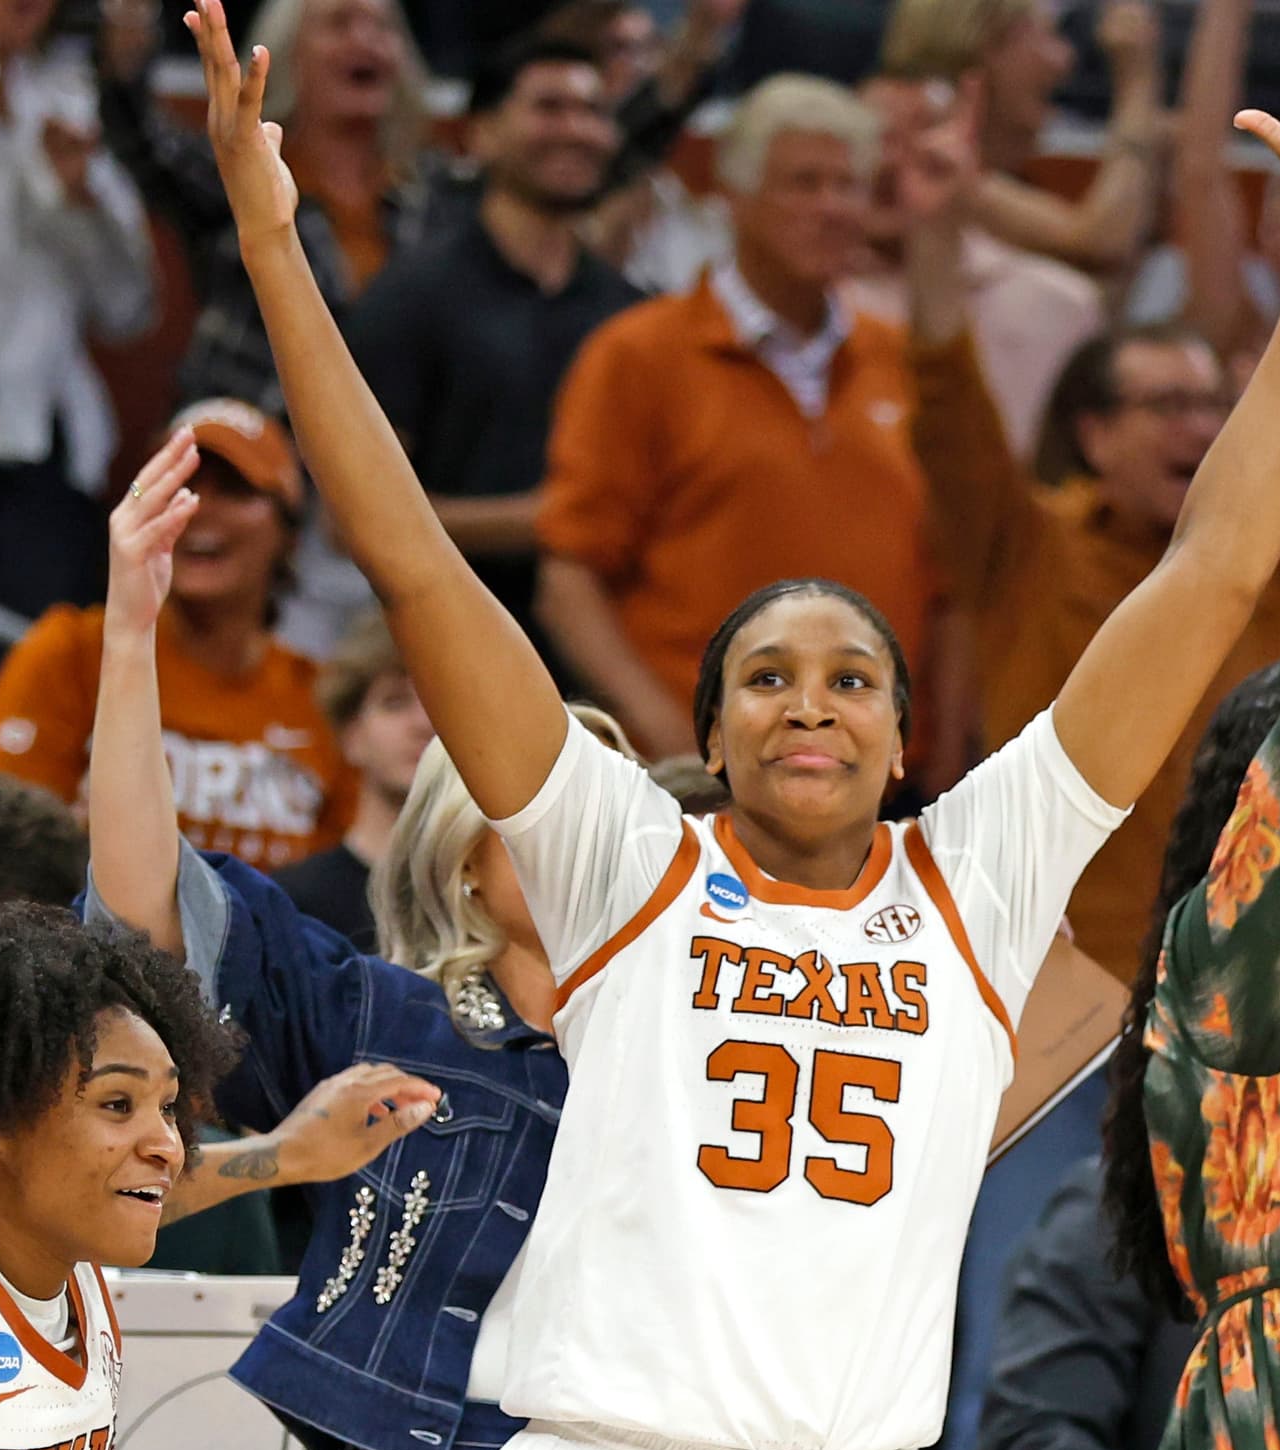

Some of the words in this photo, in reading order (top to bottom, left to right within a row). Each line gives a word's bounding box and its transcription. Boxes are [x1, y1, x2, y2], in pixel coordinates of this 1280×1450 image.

[710, 884, 745, 905] NCAA
[864, 905, 920, 942] SEC
[690, 936, 929, 1035] TEXAS
[697, 1039, 902, 1207] 35
